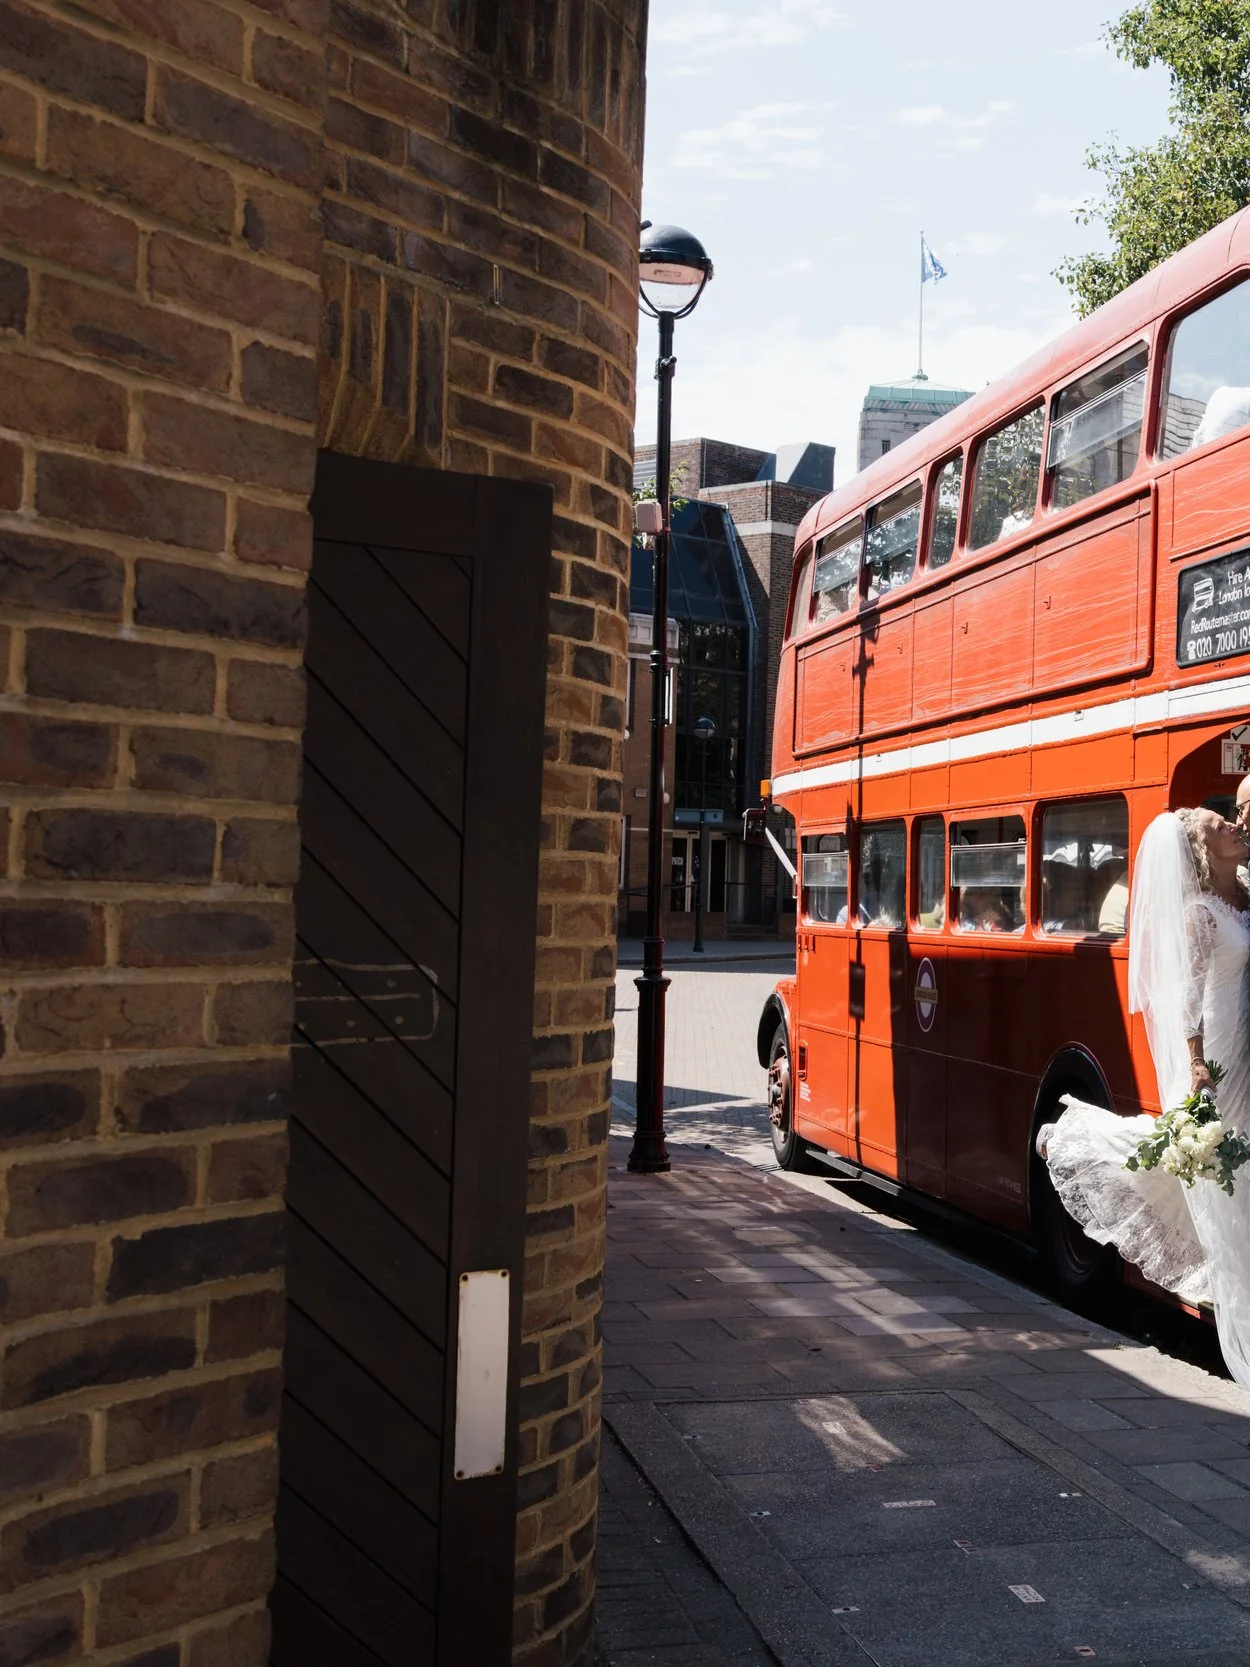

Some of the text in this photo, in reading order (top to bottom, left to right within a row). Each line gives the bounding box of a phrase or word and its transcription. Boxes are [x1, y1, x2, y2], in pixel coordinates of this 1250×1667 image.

[1228, 566, 1250, 585] Hire A
[1218, 587, 1243, 605] London
[1196, 636, 1212, 658] 020
[1215, 629, 1237, 654] 7000
